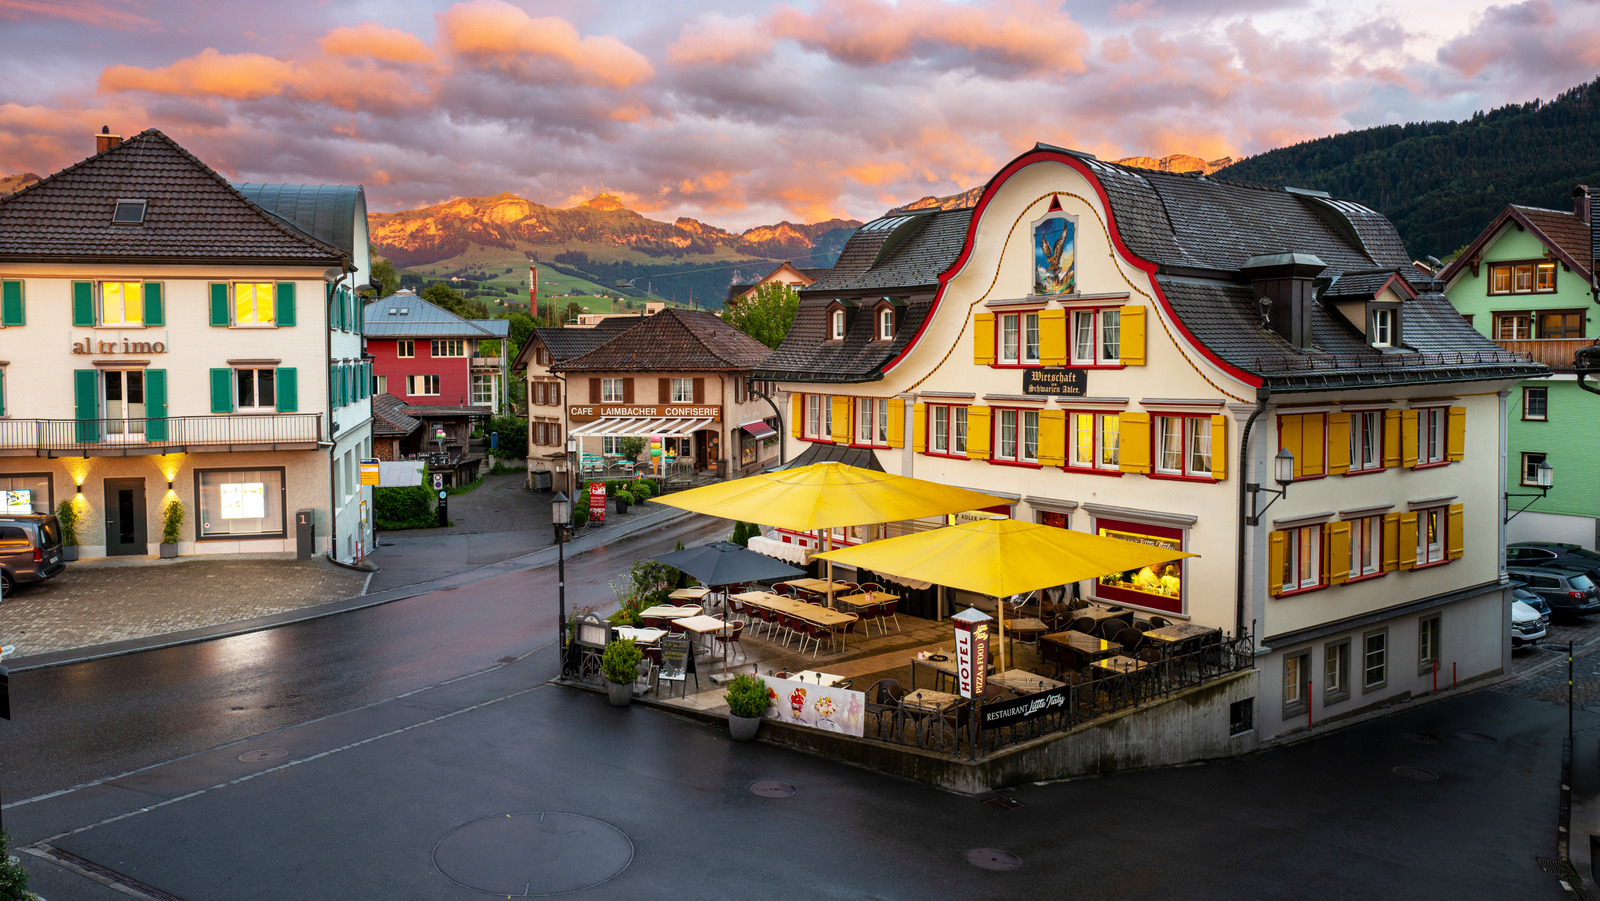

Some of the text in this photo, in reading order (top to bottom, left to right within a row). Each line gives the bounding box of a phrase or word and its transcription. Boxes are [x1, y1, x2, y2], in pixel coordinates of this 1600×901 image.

[1031, 371, 1076, 384] Wirtschaft
[571, 407, 719, 416] CAFE LAIMBACHER CONFISERIE
[299, 514, 307, 525] 1
[960, 637, 970, 692] HOTEL
[987, 704, 1029, 721] RESTAURANT
[1024, 698, 1047, 716] Little
